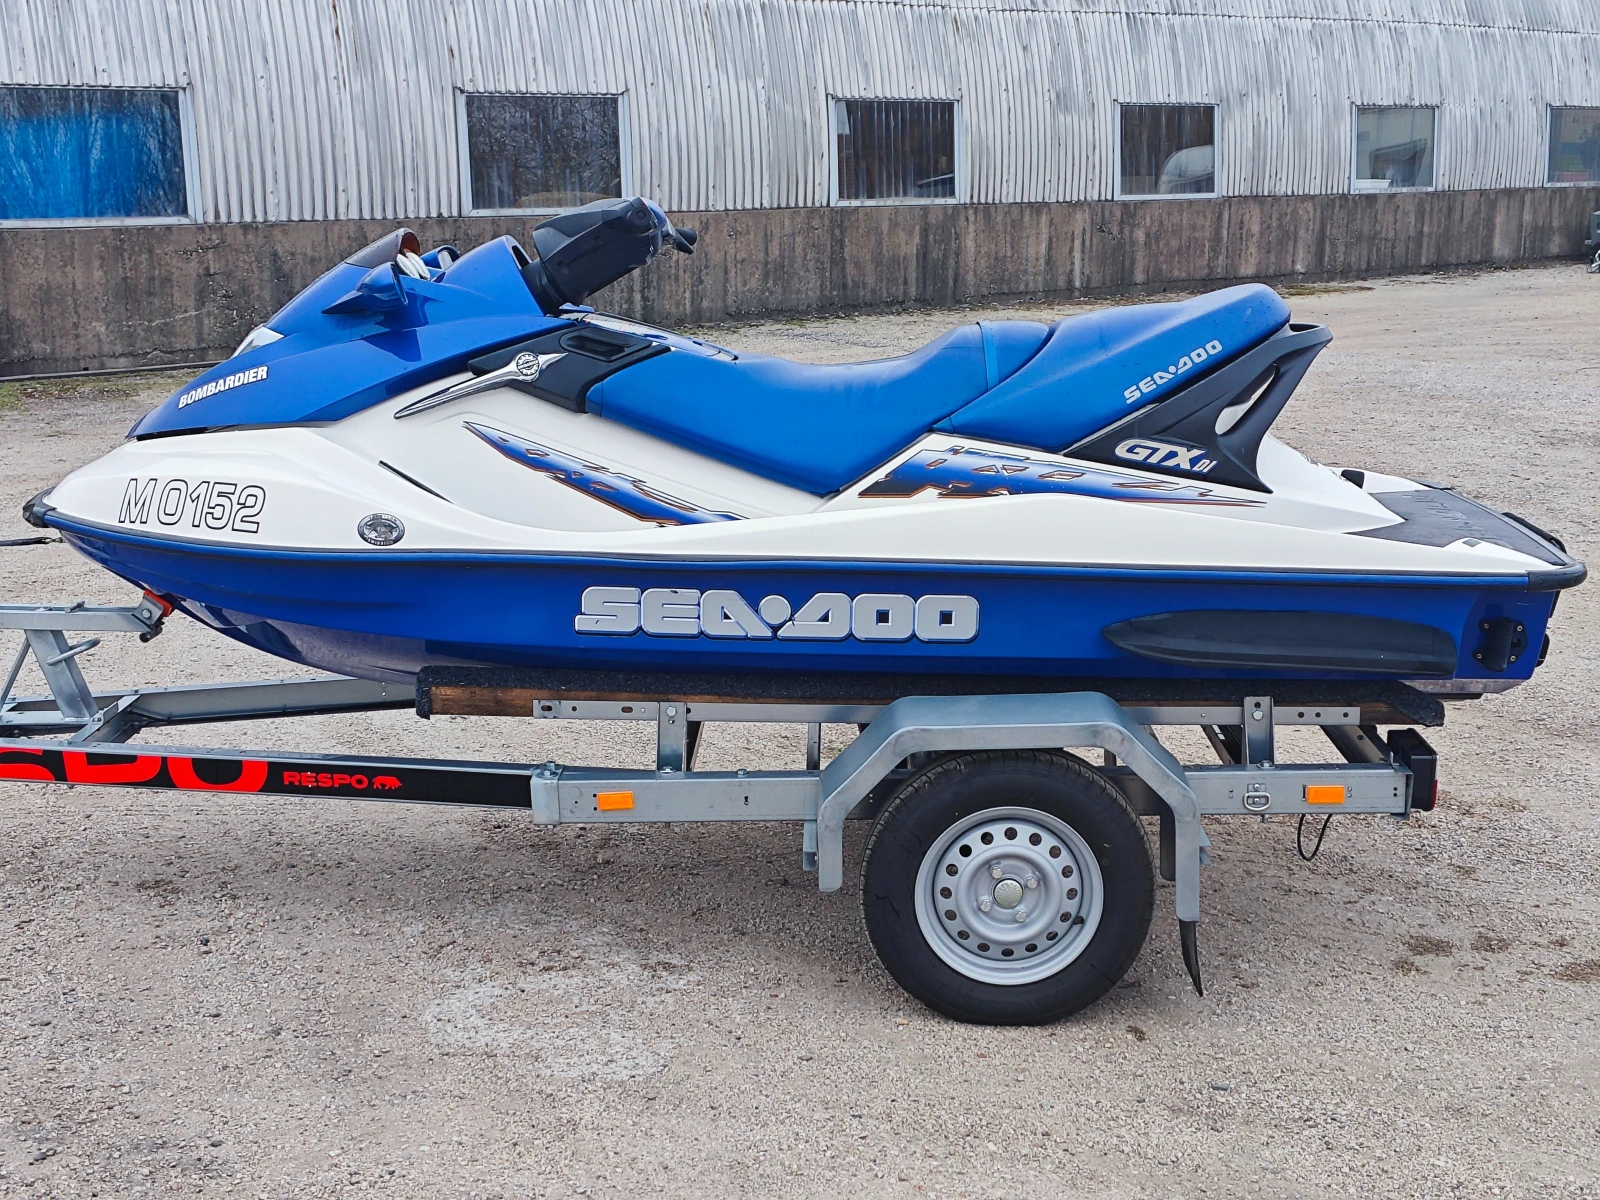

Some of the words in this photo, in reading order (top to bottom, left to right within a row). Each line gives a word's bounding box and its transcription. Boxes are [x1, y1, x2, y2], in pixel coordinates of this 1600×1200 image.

[178, 365, 269, 410] BOMBARDIER
[1114, 438, 1207, 470] GTX
[283, 771, 369, 789] RESPO
